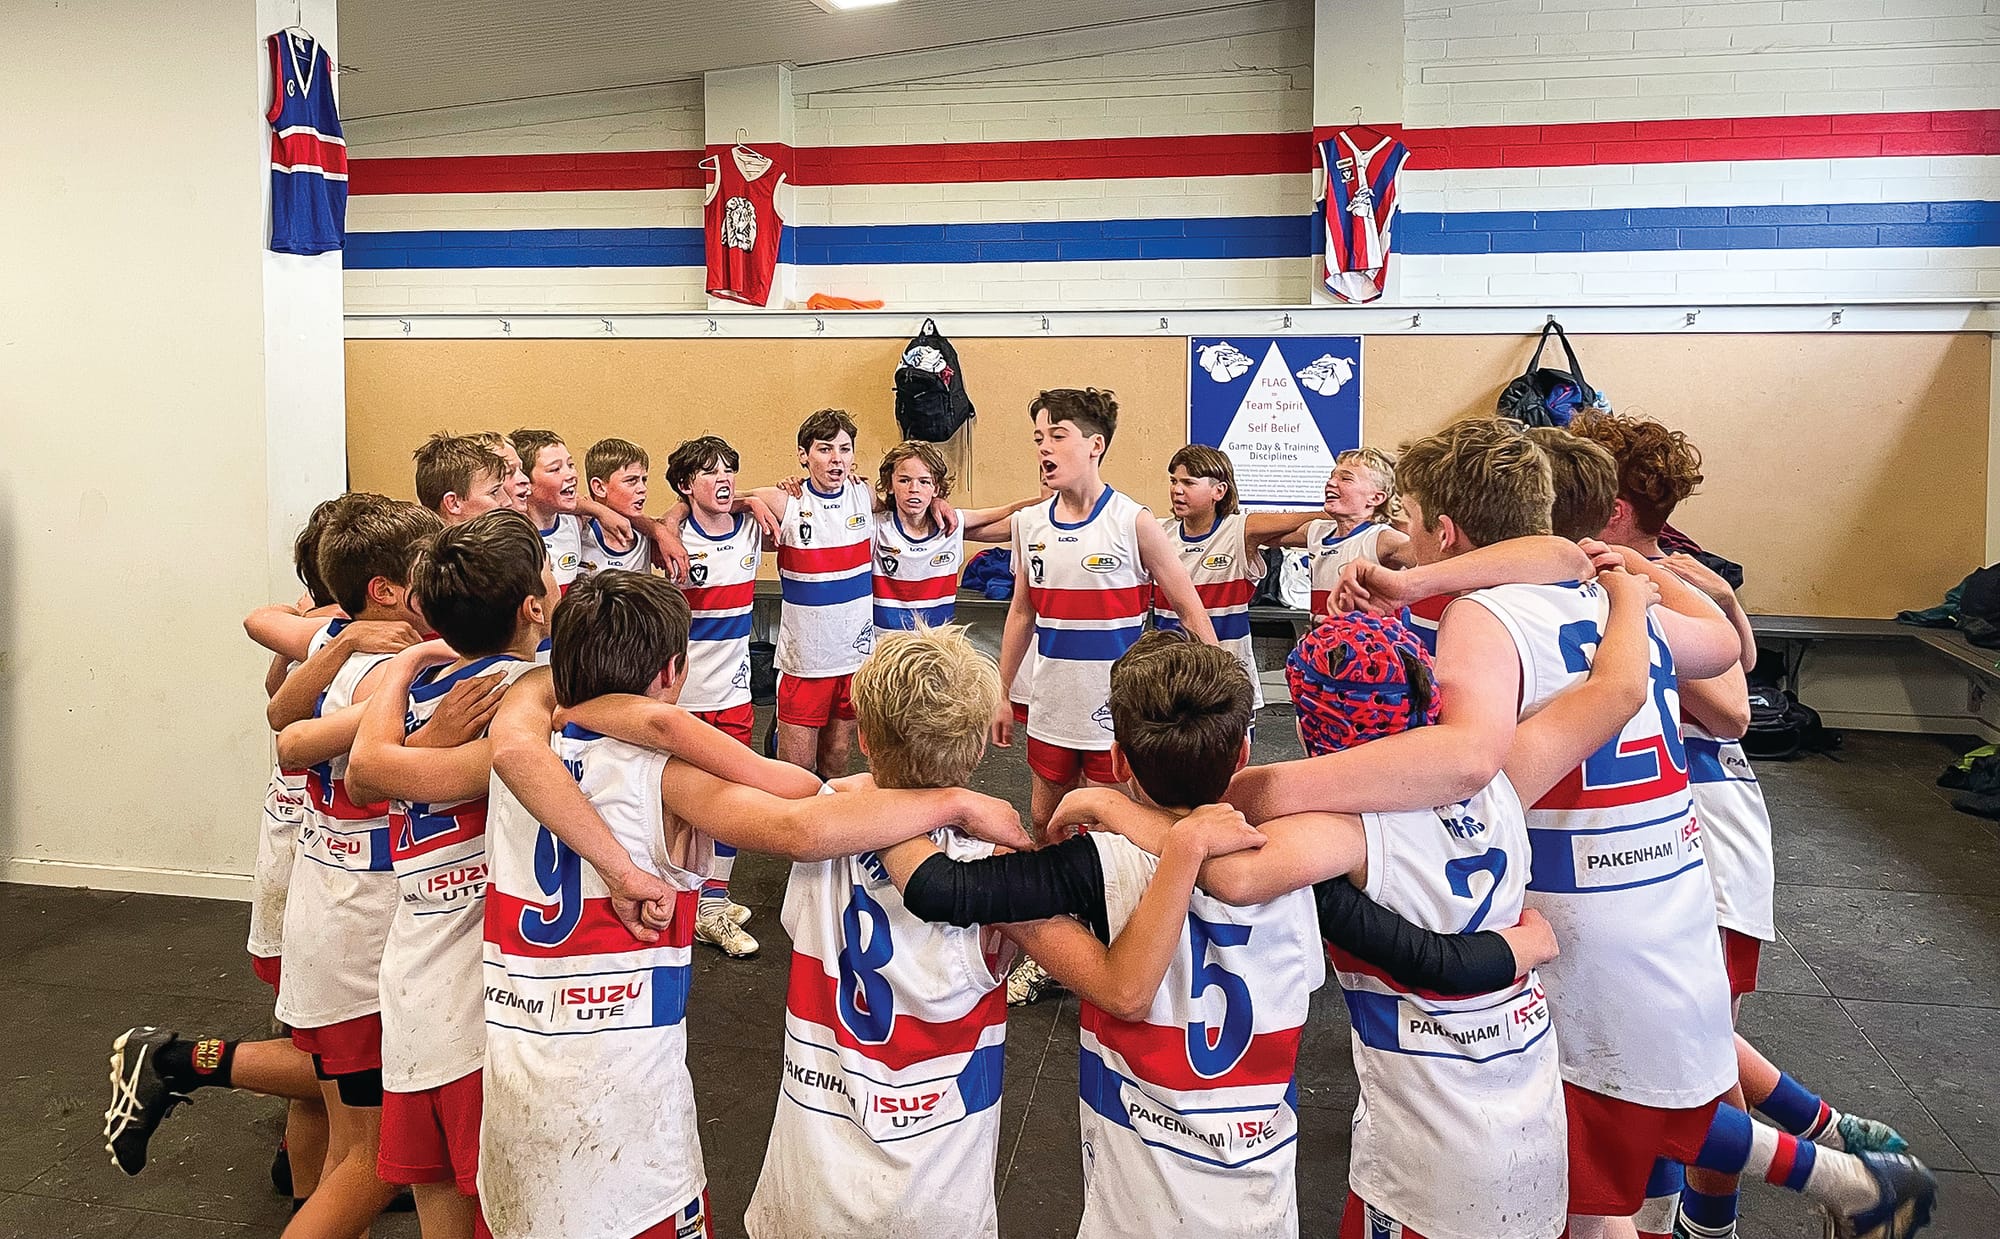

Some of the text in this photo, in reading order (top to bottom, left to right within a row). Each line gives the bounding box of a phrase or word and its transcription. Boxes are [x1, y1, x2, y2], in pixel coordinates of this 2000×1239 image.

[1261, 378, 1287, 387] FLAG
[1246, 400, 1303, 412] Team Spirit
[1248, 423, 1301, 433] Self Belief
[1228, 441, 1320, 453] Game Day & Training
[1249, 451, 1298, 462] Disciplines
[1098, 557, 1114, 565] RSL
[278, 805, 295, 815] TE
[1587, 841, 1673, 870] PAKENHAM
[519, 823, 584, 948] 9
[1444, 847, 1508, 935] 2
[836, 884, 894, 1045] 8
[560, 982, 643, 1006] ISUZU
[1184, 909, 1254, 1080] 5
[576, 1004, 625, 1021] UTE
[873, 1091, 947, 1113] ISUZ
[891, 1113, 933, 1128] UT
